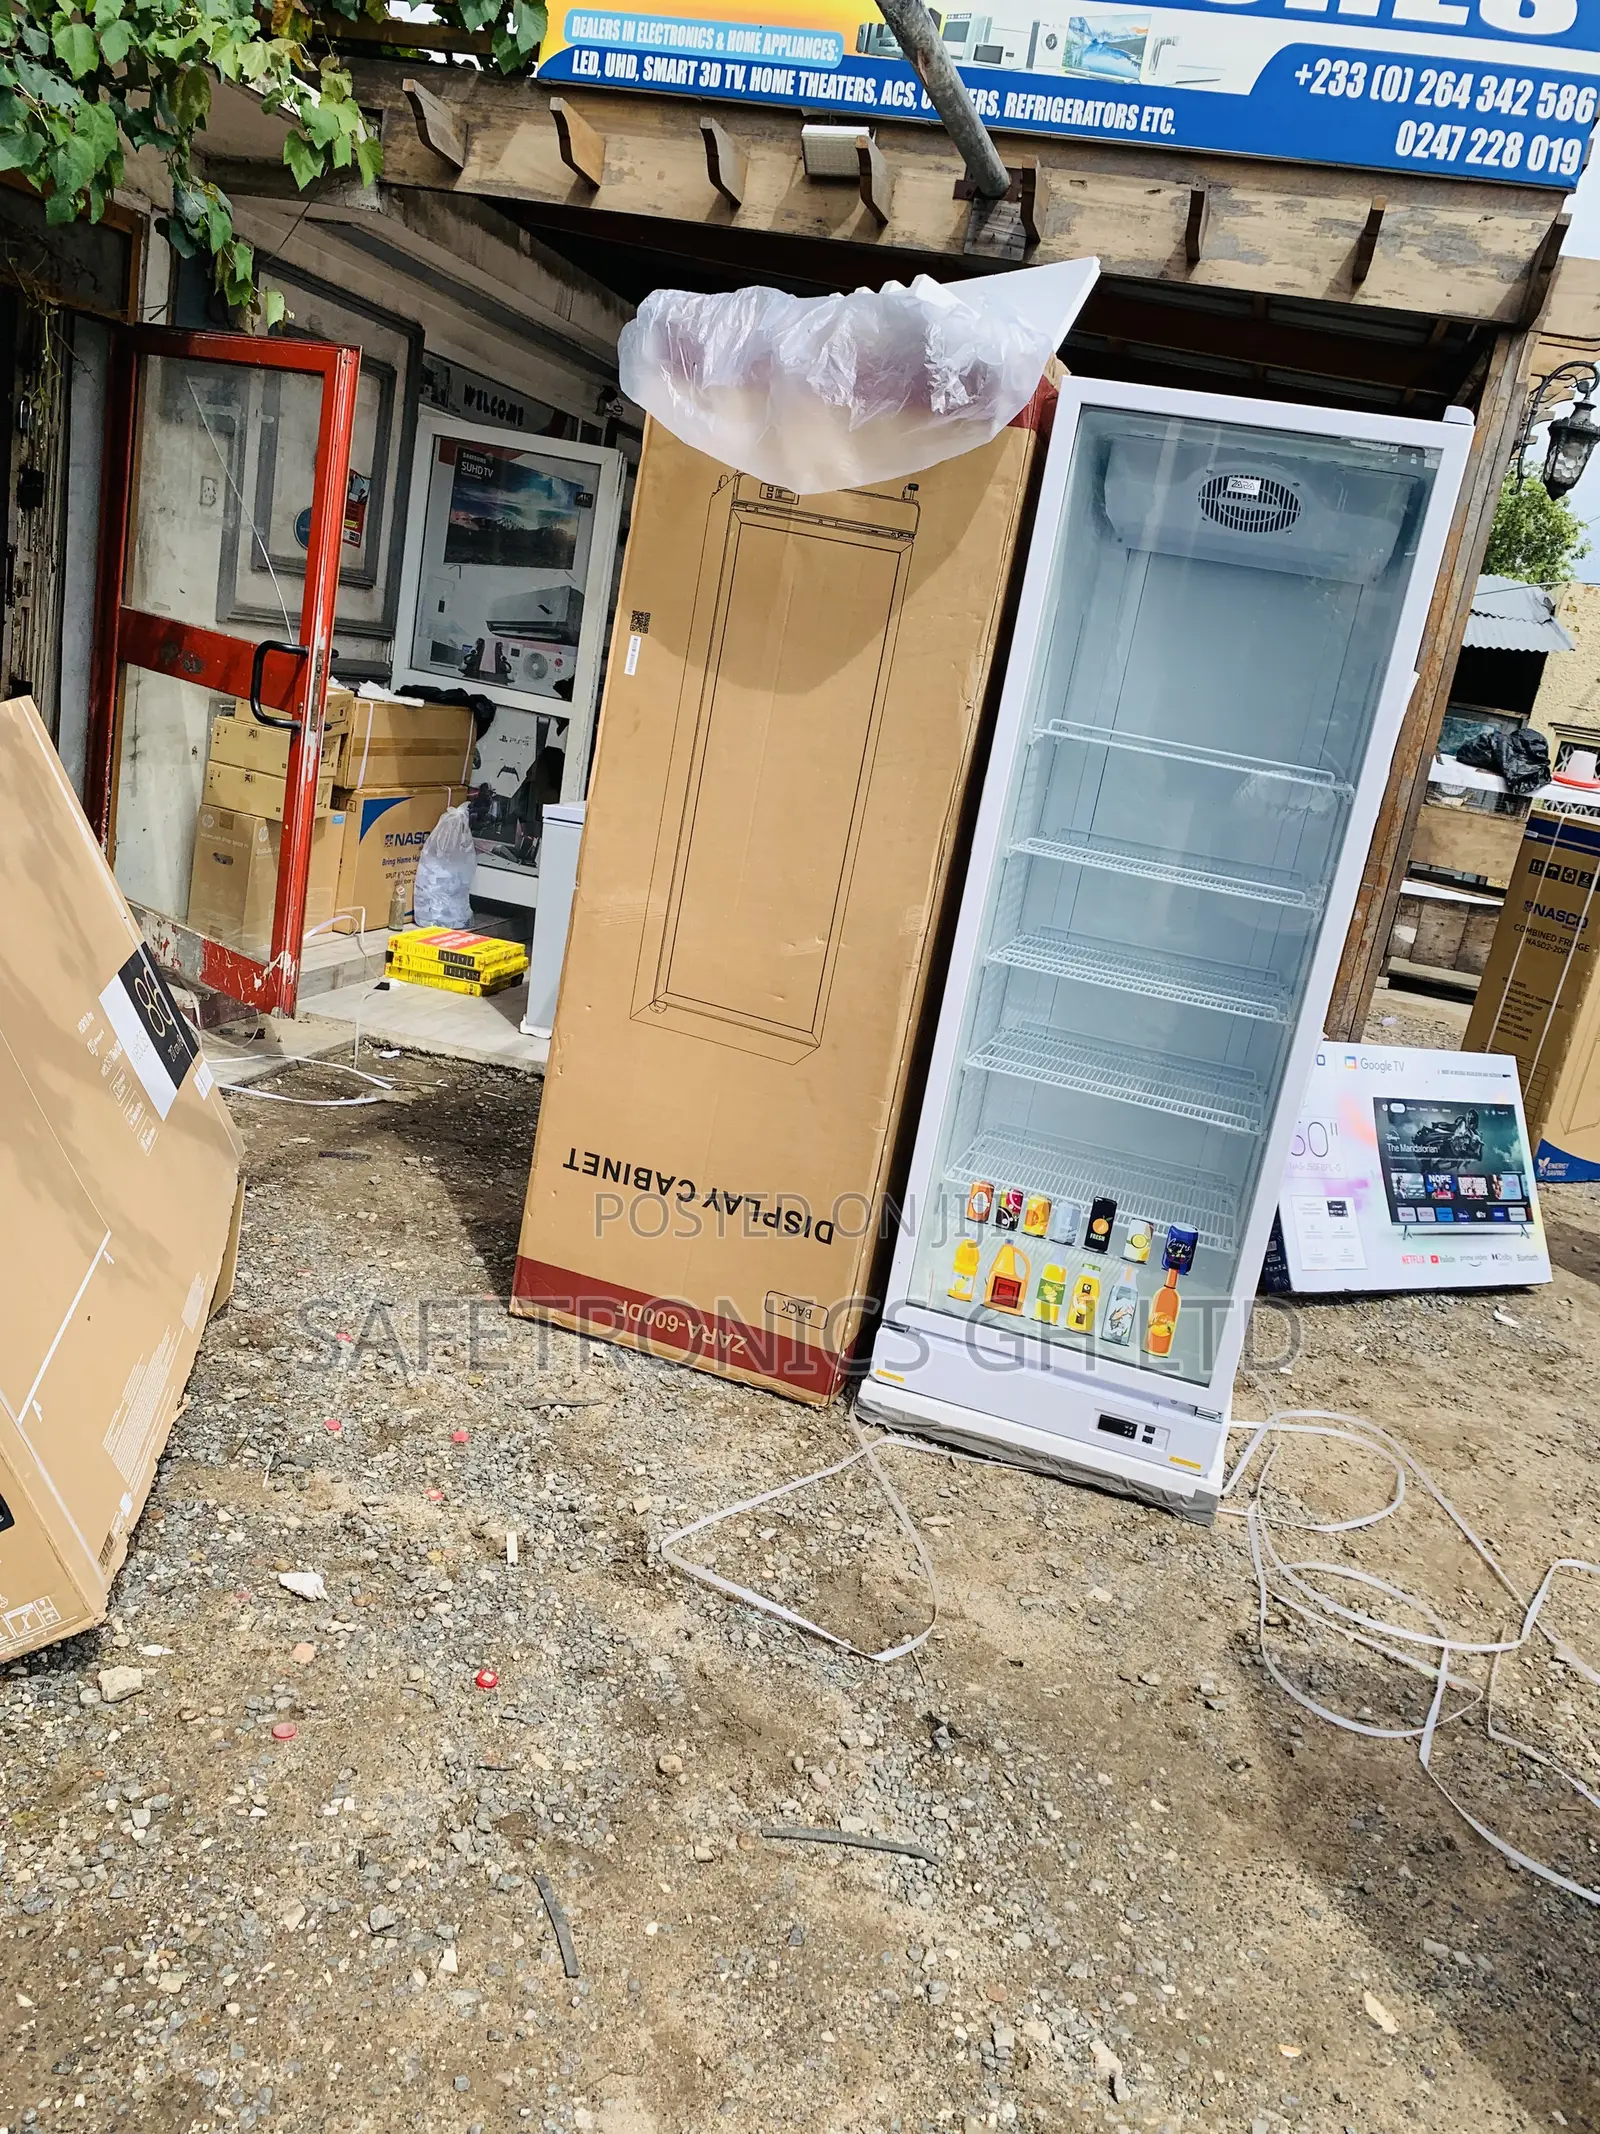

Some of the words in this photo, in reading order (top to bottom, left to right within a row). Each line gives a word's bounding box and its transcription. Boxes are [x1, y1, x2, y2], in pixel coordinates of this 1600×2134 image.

[571, 16, 621, 40] DEALERS
[622, 20, 635, 43] IN
[637, 21, 714, 50] ELECTRONICS
[715, 31, 724, 51] &
[727, 30, 762, 53] HOME
[762, 33, 839, 62] APPLIANCES:
[572, 49, 602, 78] LED,
[604, 53, 640, 82] UHD,
[642, 56, 698, 86] SMART
[699, 62, 721, 88] 3D
[724, 64, 747, 93] TV,
[749, 67, 797, 96] HOME
[798, 71, 878, 106] THEATERS,
[880, 79, 917, 110] ACS,
[1003, 91, 1139, 131] REFRIGERATORS
[1140, 107, 1176, 135] ETC.
[1294, 58, 1366, 99] +233
[1370, 65, 1415, 104] (0)
[1420, 72, 1471, 110] 264
[1477, 77, 1534, 118] 342
[1537, 83, 1597, 124] 586
[1396, 119, 1466, 162] 0247
[1470, 126, 1522, 169] 228
[1527, 132, 1583, 175] 019
[464, 384, 524, 427] WELCOME
[461, 461, 483, 475] SUHD
[484, 467, 494, 478] TV
[1231, 479, 1256, 491] ZARA
[1532, 903, 1589, 929] NASCO
[1513, 923, 1558, 943] COMBINED
[1360, 1057, 1392, 1073] Google
[1393, 1060, 1405, 1072] TV
[1387, 1143, 1399, 1152] The
[1400, 1143, 1440, 1154] Mandalorian
[562, 1147, 696, 1203] CABINET
[1428, 1174, 1453, 1184] NOPE
[702, 1188, 835, 1245] DISPLAY
[1089, 1233, 1106, 1242] FRESH
[1402, 1255, 1425, 1265] NETFLIX
[781, 1299, 813, 1320] BACK
[613, 1299, 749, 1355] ZARA-600DF
